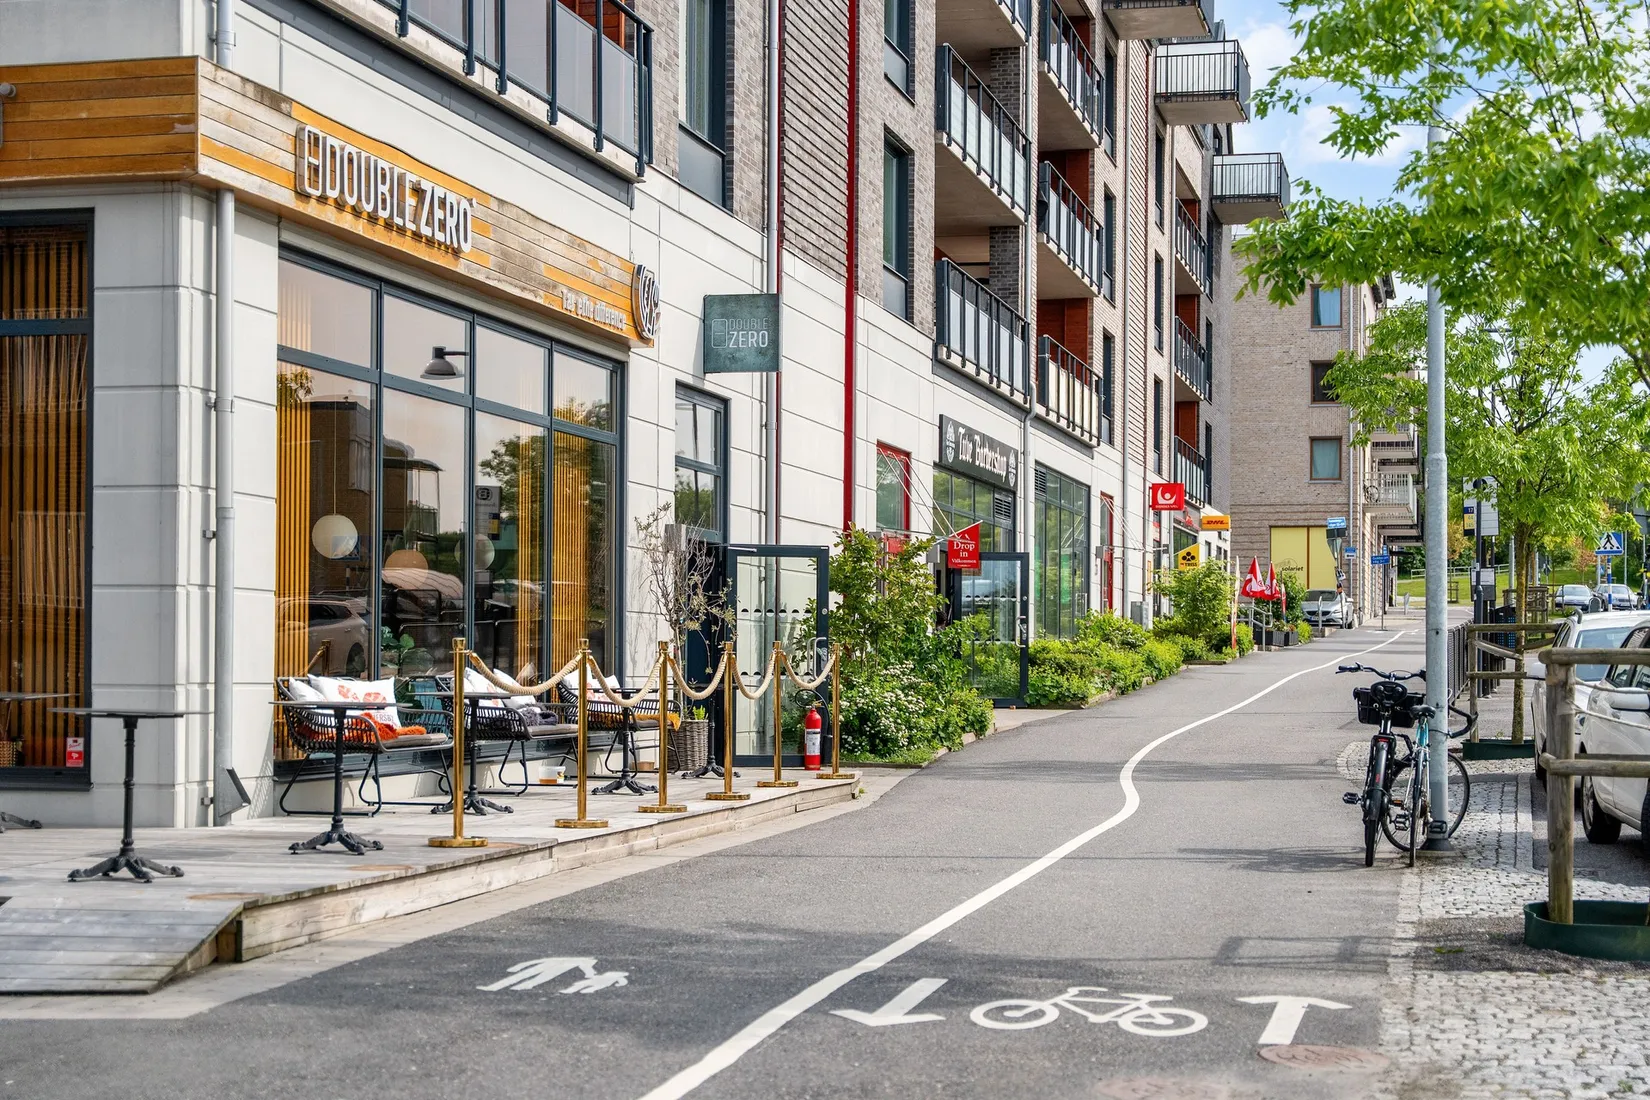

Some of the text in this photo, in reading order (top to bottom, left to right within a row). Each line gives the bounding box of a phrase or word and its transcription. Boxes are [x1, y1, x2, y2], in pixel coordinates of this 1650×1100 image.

[324, 134, 473, 254] DOUBLE ZERO
[729, 318, 769, 330] DOUBLE
[729, 331, 769, 348] ZERO
[974, 434, 1007, 483] Barbershop
[953, 541, 975, 551] Drop
